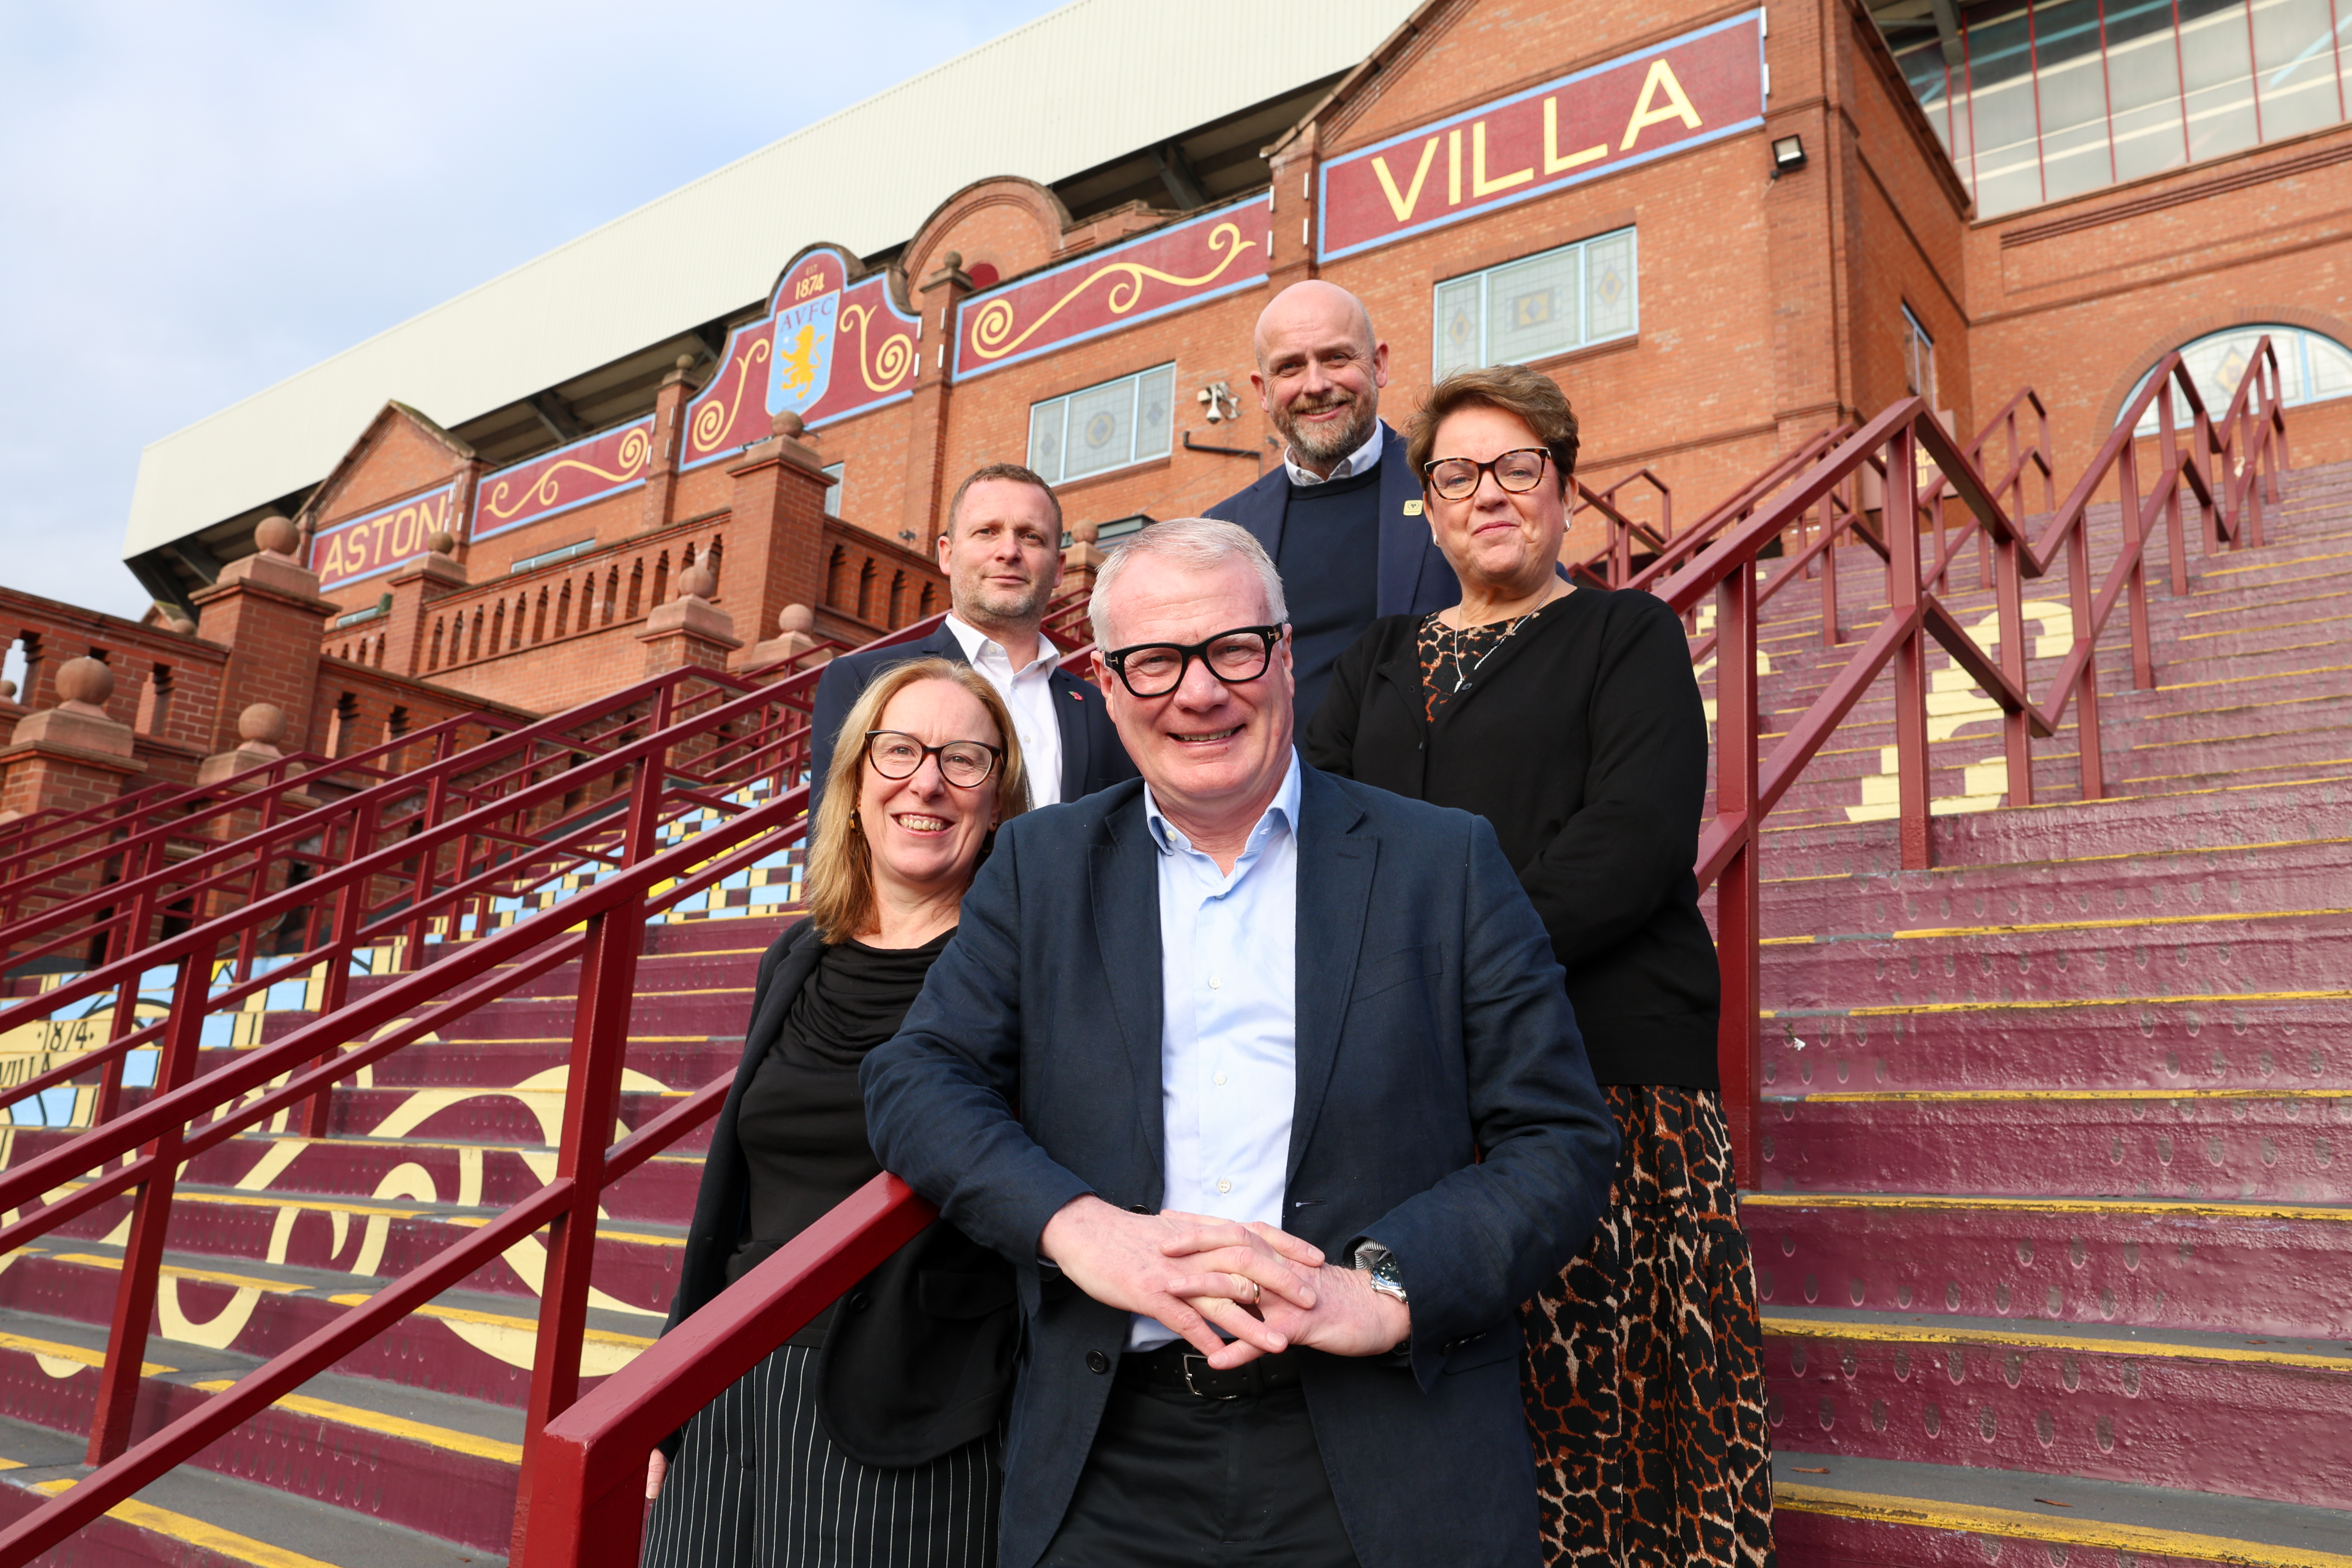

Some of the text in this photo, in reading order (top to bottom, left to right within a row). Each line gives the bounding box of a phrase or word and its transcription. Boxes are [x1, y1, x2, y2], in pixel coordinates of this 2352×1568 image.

[1371, 58, 1702, 222] VILLA
[780, 297, 834, 333] AVFC
[795, 272, 825, 300] 1874
[319, 495, 446, 583] ASTON
